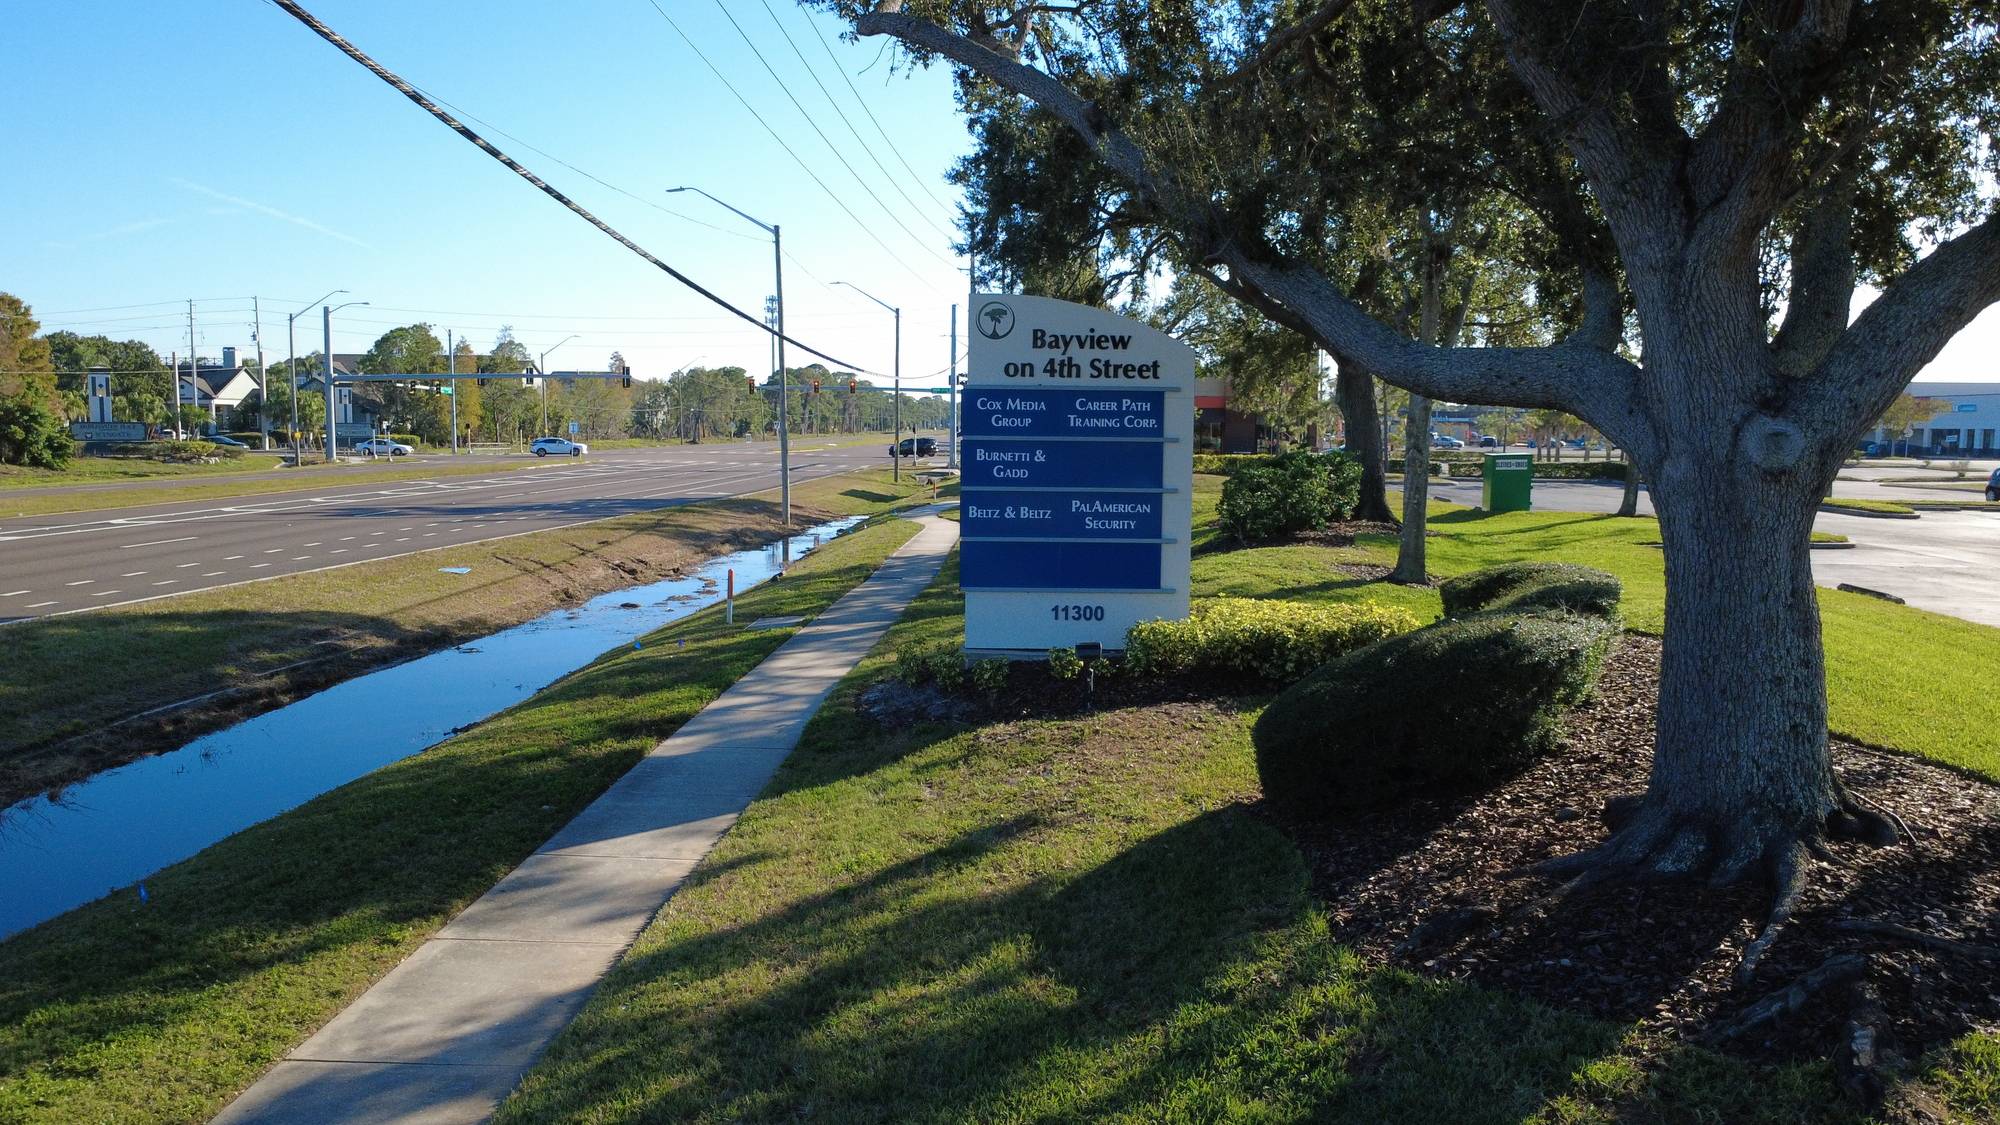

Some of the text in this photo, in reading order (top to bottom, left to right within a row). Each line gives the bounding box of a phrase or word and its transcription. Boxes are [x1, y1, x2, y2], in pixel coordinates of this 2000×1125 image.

[1032, 328, 1131, 355] Bayview
[1004, 357, 1160, 379] on 4th Street
[977, 398, 1046, 410] COX MEDIA
[1076, 399, 1150, 411] CAREER PATH
[992, 415, 1031, 427] GROUP
[1068, 415, 1157, 427] TRAINING CORP.
[977, 449, 1045, 461] BURNETTI &
[993, 465, 1028, 478] GADD
[969, 506, 1051, 518] BELTZ & BELTZ
[1086, 517, 1136, 529] SECURITY
[1052, 605, 1104, 621] 11300
